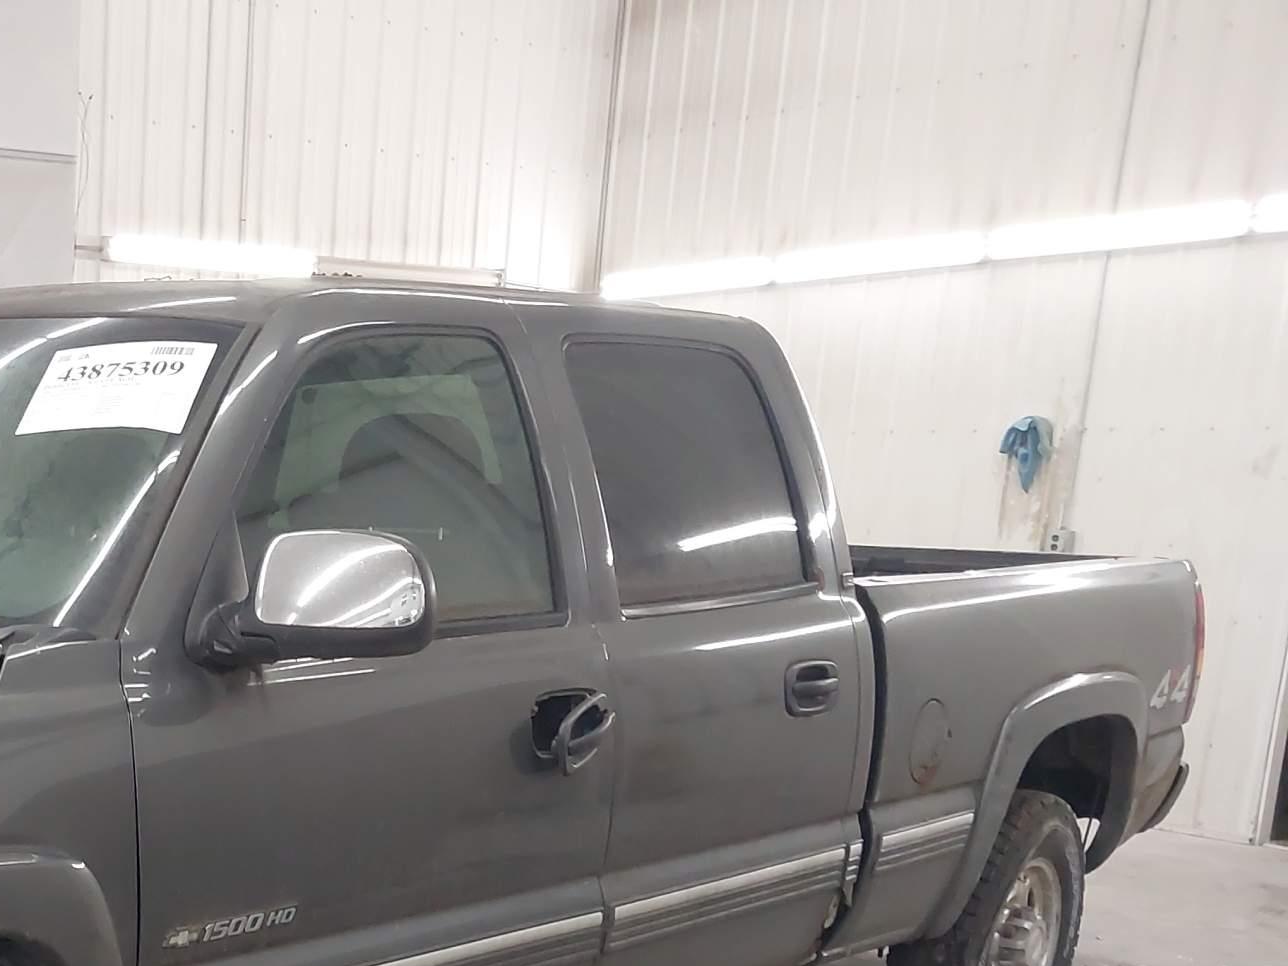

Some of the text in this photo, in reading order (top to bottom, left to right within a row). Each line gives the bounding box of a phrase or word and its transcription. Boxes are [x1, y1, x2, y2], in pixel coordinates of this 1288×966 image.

[56, 360, 185, 382] 43875309
[202, 907, 297, 942] 1500 HD
